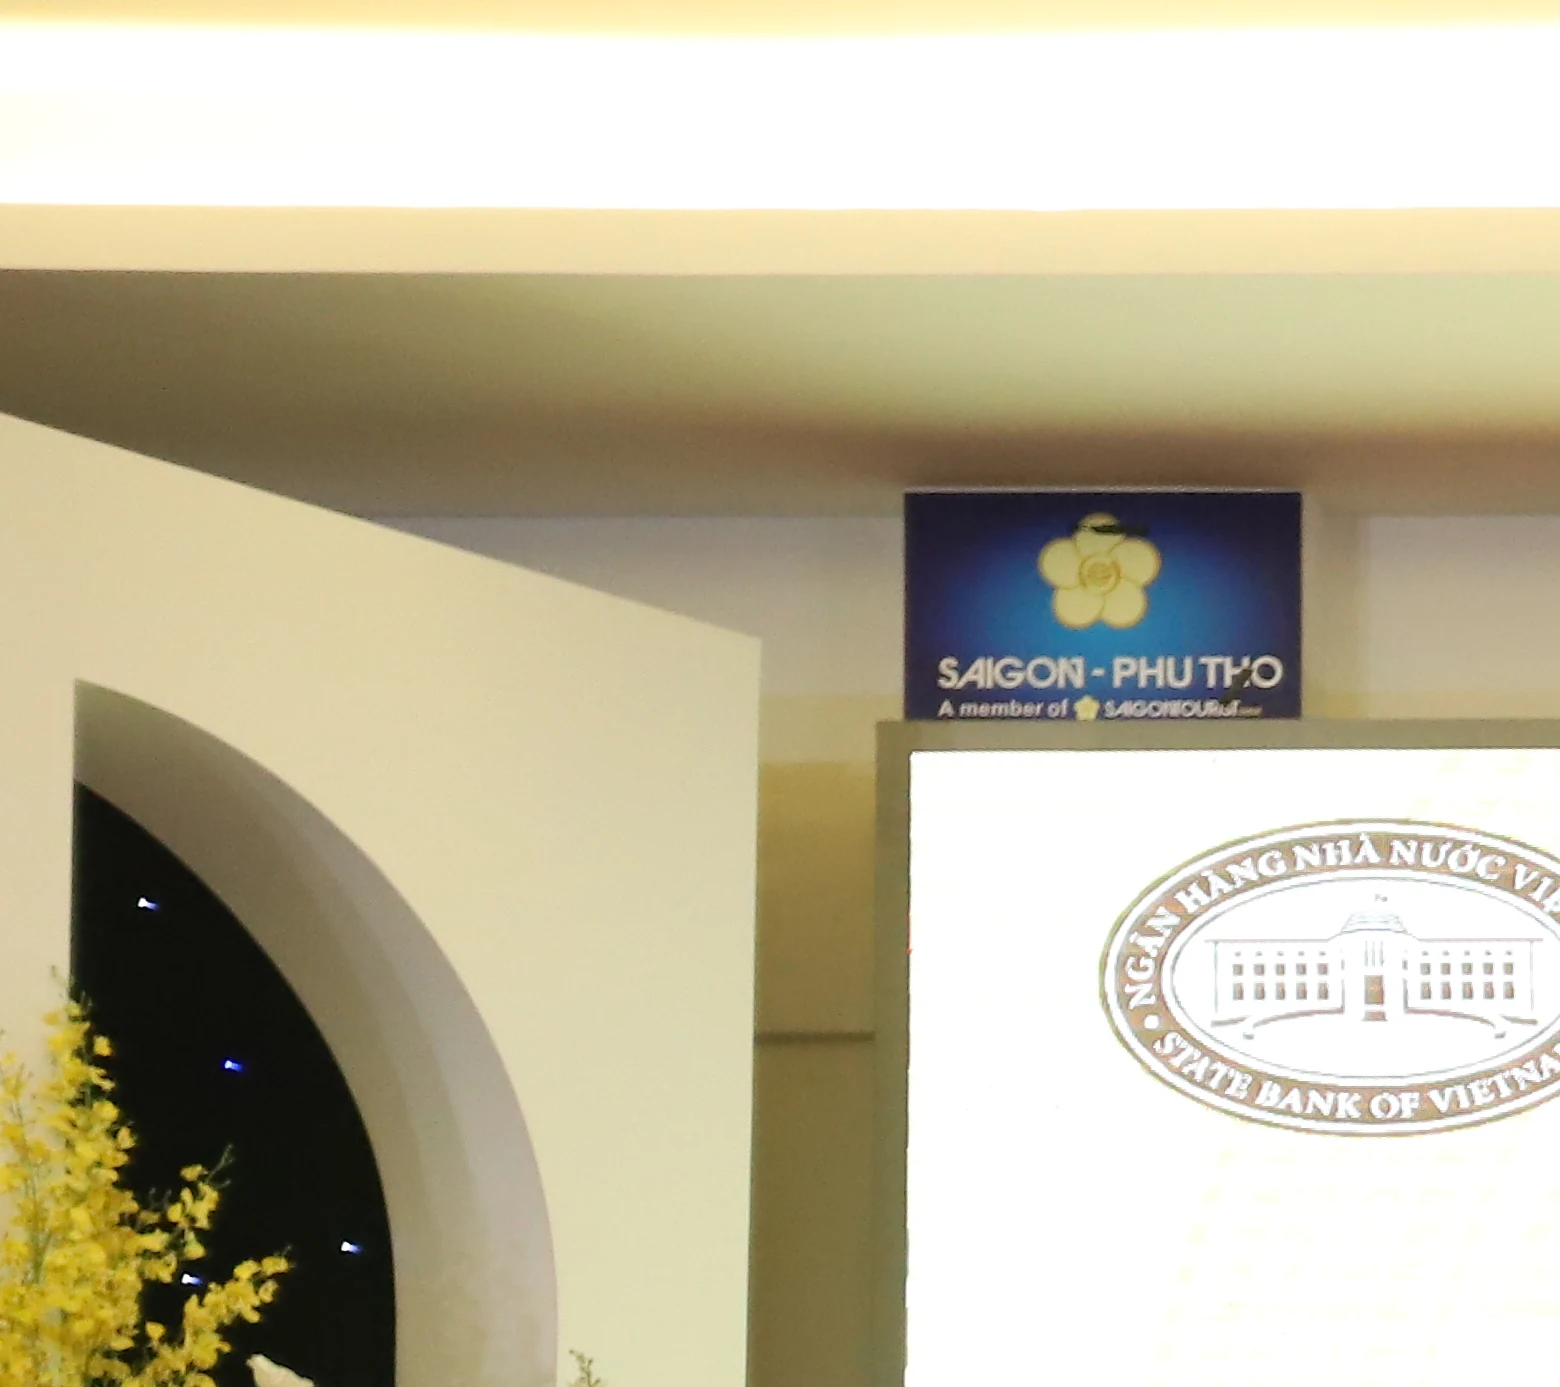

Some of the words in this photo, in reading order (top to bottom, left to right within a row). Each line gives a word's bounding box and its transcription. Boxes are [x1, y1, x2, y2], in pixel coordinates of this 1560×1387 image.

[937, 655, 1085, 690] SAIGON
[1112, 655, 1194, 690] PHU
[937, 698, 956, 718] A
[959, 698, 1044, 718] member
[1047, 697, 1070, 718] of
[1123, 905, 1180, 1010] NGÂN
[1174, 843, 1288, 918] HÀNG
[1292, 832, 1384, 872] NHÀ
[1389, 835, 1509, 883] NƯỚC
[1151, 1030, 1251, 1101] STATE
[1255, 1081, 1363, 1121] BANK
[1369, 1089, 1422, 1120] OF
